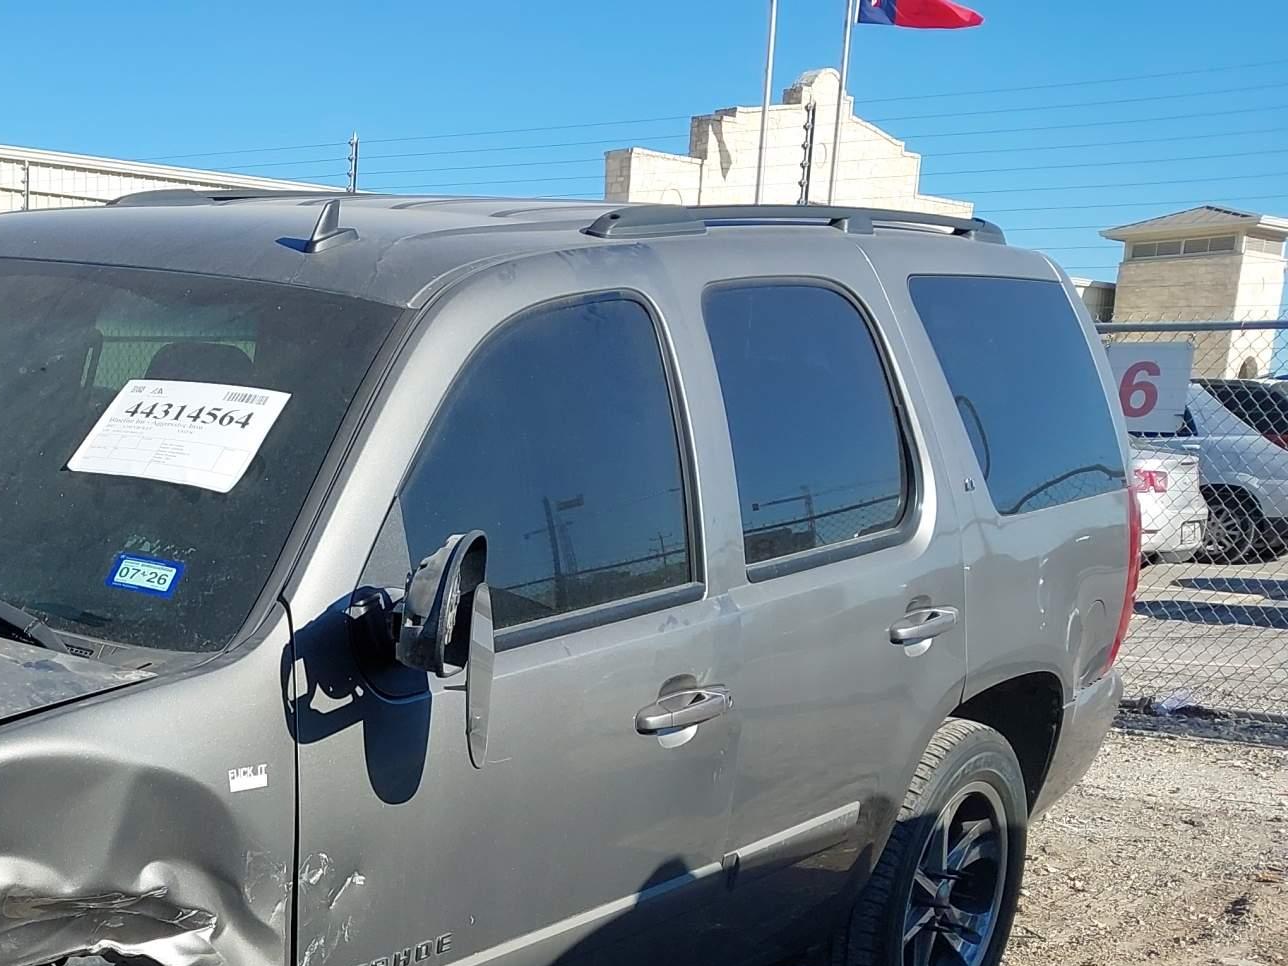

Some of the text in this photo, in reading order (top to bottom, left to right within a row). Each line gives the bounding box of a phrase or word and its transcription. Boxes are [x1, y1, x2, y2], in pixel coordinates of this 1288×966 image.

[1119, 360, 1161, 418] 6
[124, 400, 254, 429] 44314564
[118, 566, 141, 579] 07
[146, 571, 169, 586] 26
